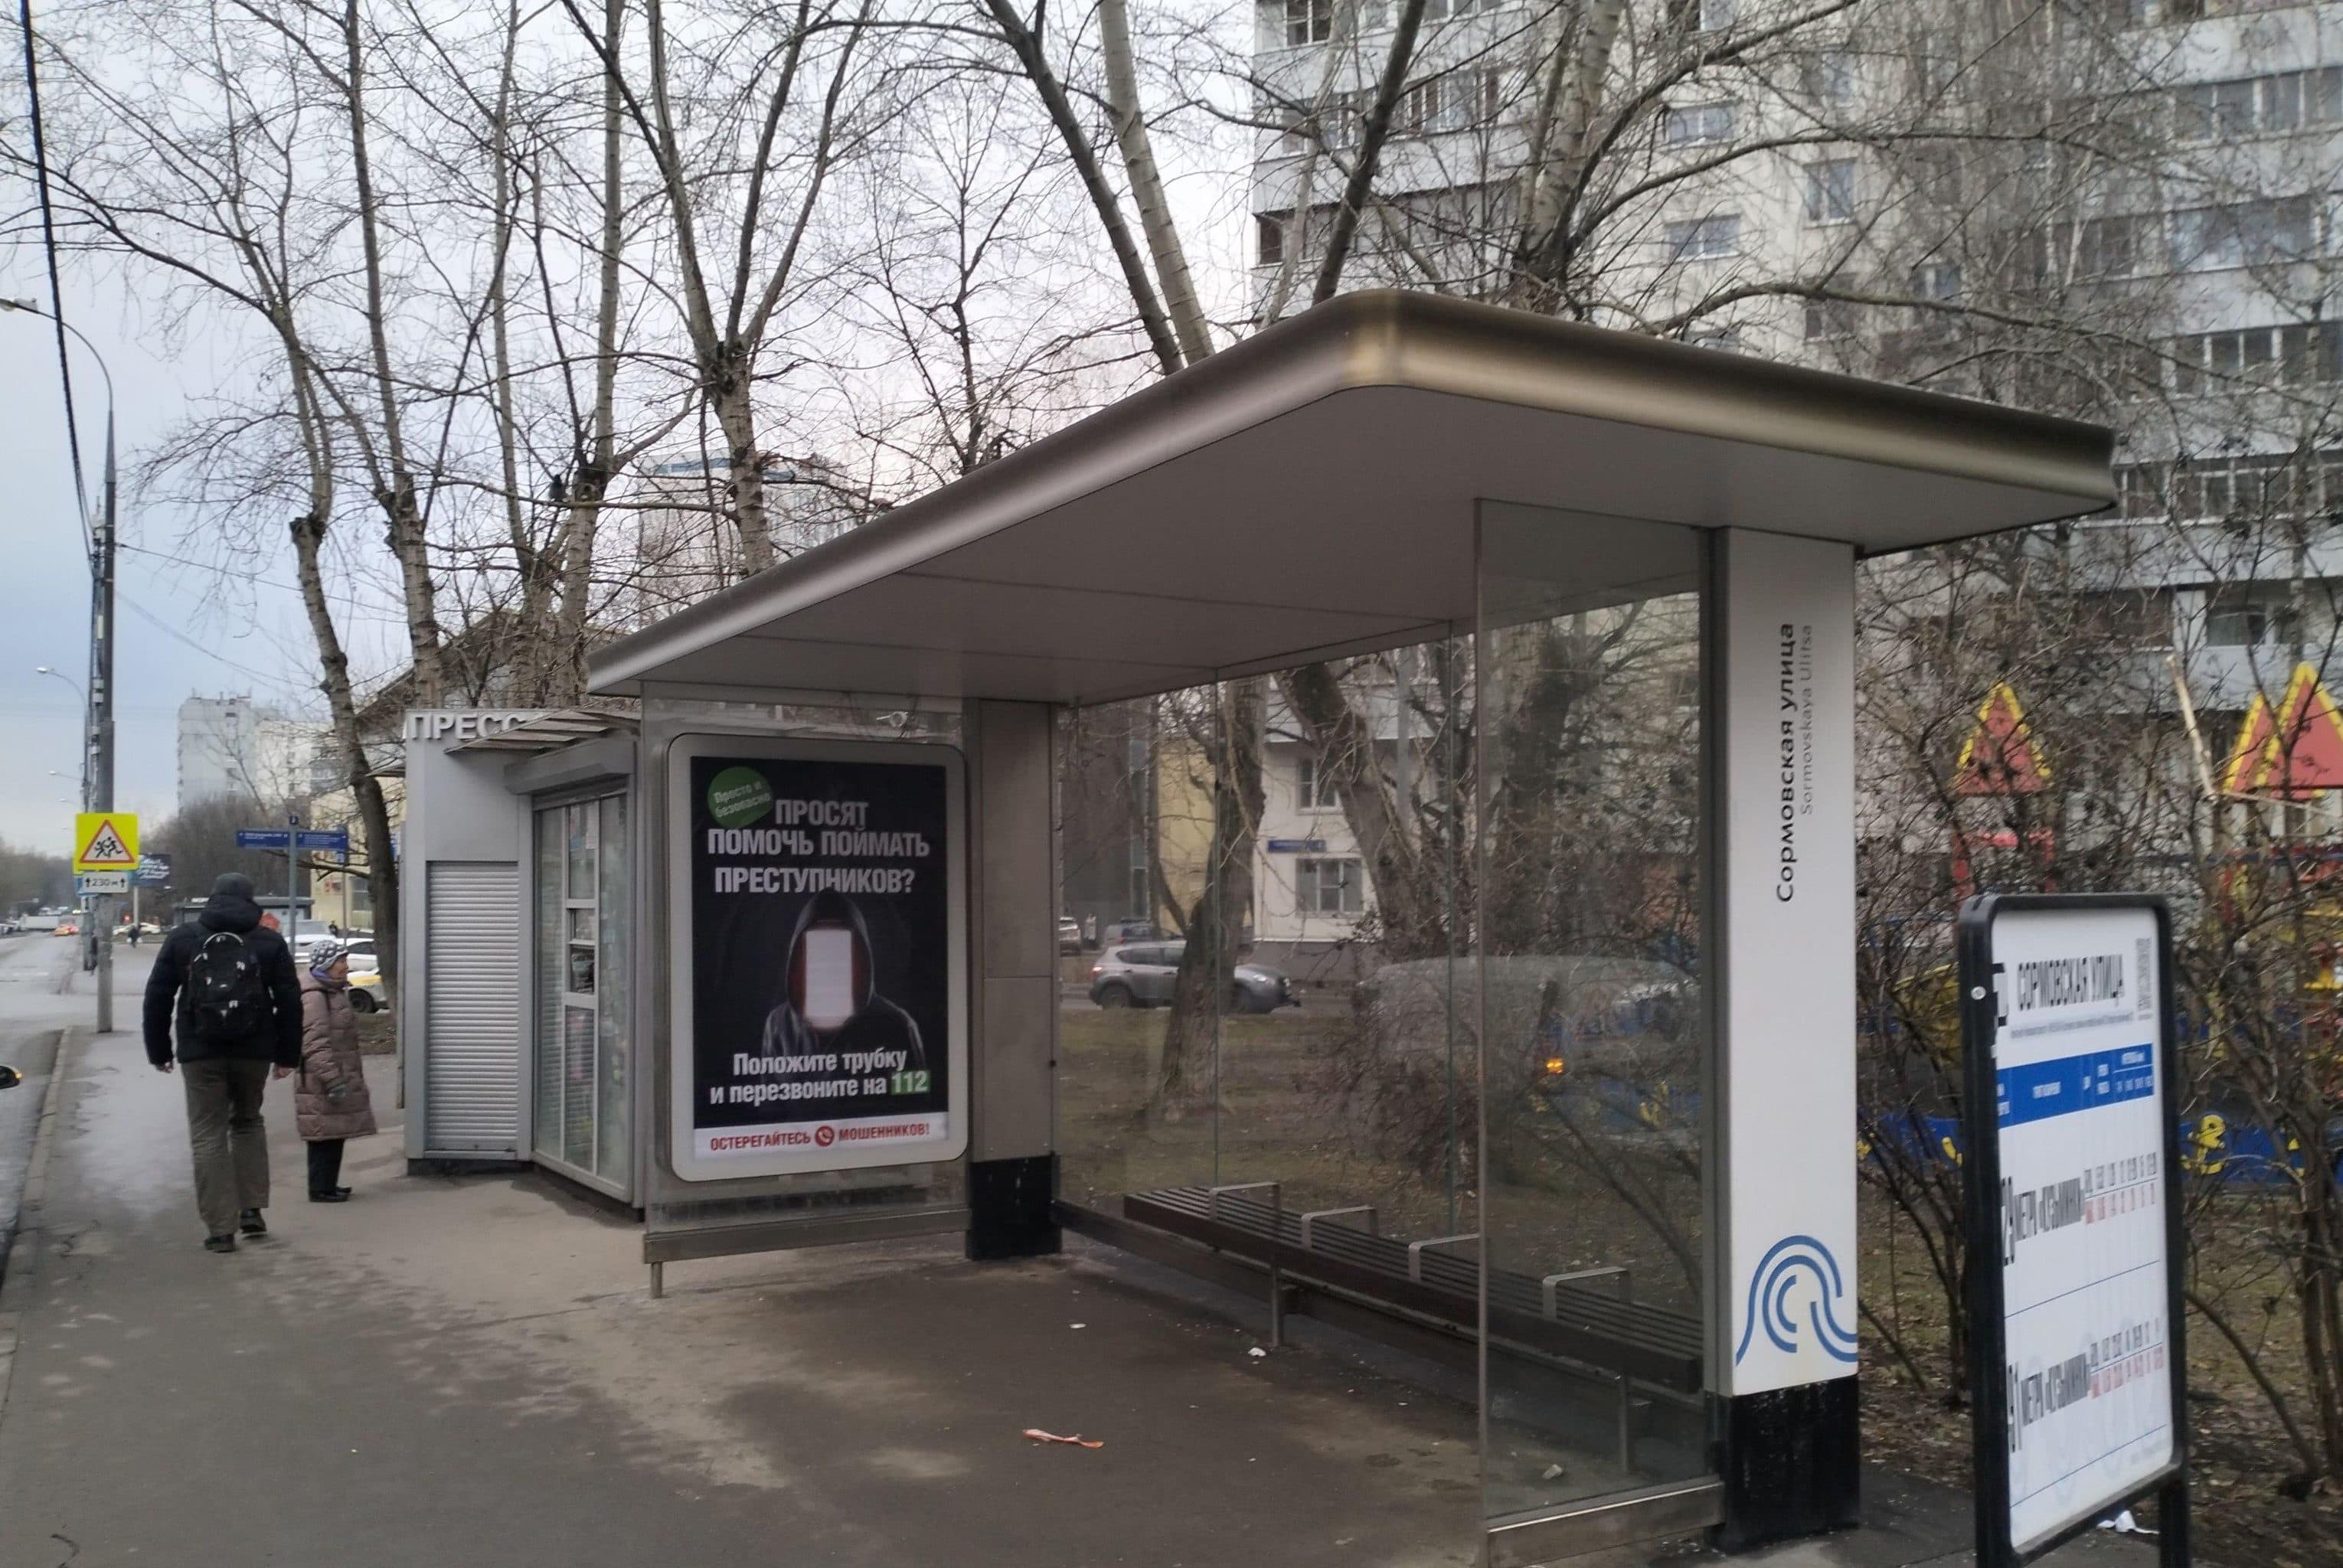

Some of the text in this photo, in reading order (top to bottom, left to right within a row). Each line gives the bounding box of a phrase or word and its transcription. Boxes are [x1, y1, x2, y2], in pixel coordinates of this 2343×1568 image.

[1776, 623, 1798, 902] Сормовская улица
[1801, 688, 1814, 815] Sormovskaya
[775, 799, 869, 825] ПРОСЯТ
[707, 827, 930, 858] ПОМОЧЬ ПОЙМАТЬ
[715, 867, 915, 893] ПРЕСТУПНИКОВ?
[733, 1047, 907, 1076] Положите трубку
[710, 1071, 928, 1107] и перезвоните на 112
[710, 1123, 930, 1151] ОСТЕРЕГАЙТЕСЬ МОШЕННИКОВ!
